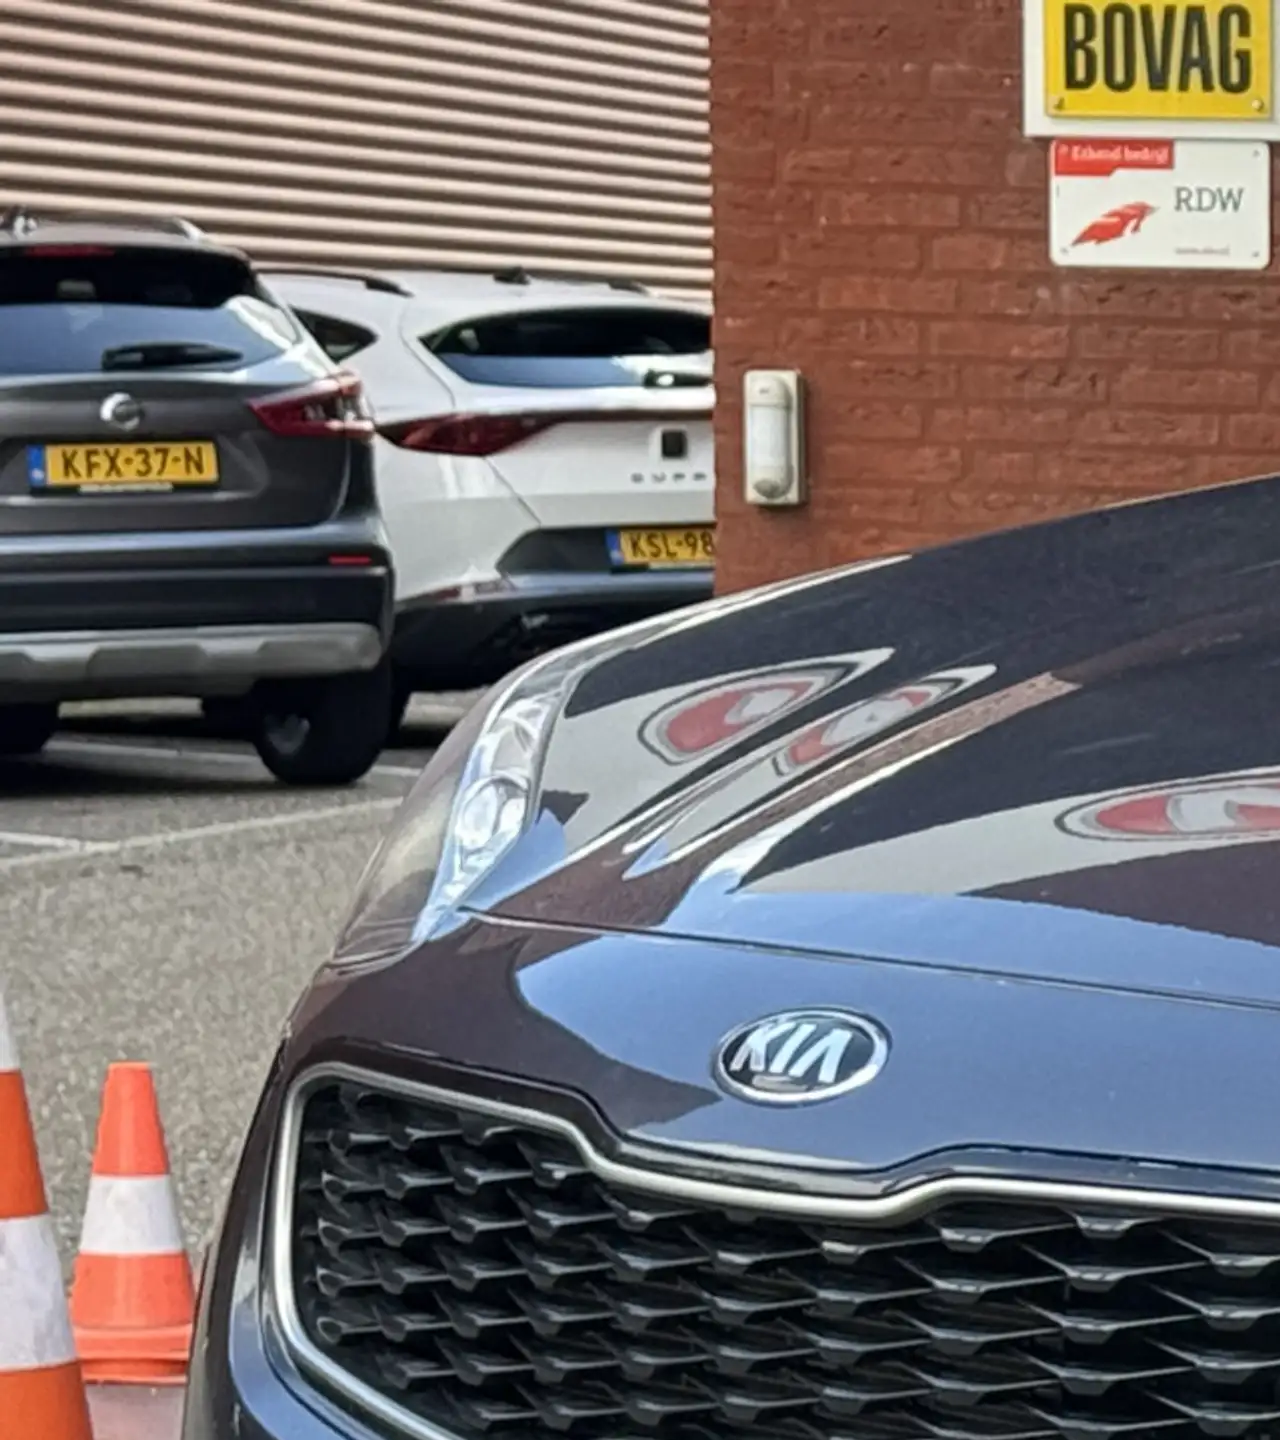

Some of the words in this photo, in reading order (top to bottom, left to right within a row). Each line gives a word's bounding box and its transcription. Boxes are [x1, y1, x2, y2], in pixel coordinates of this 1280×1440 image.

[1064, 3, 1252, 94] BOVAG
[1174, 186, 1245, 214] RDW
[61, 446, 205, 478] KFX-37-N
[730, 1021, 853, 1084] KIA
